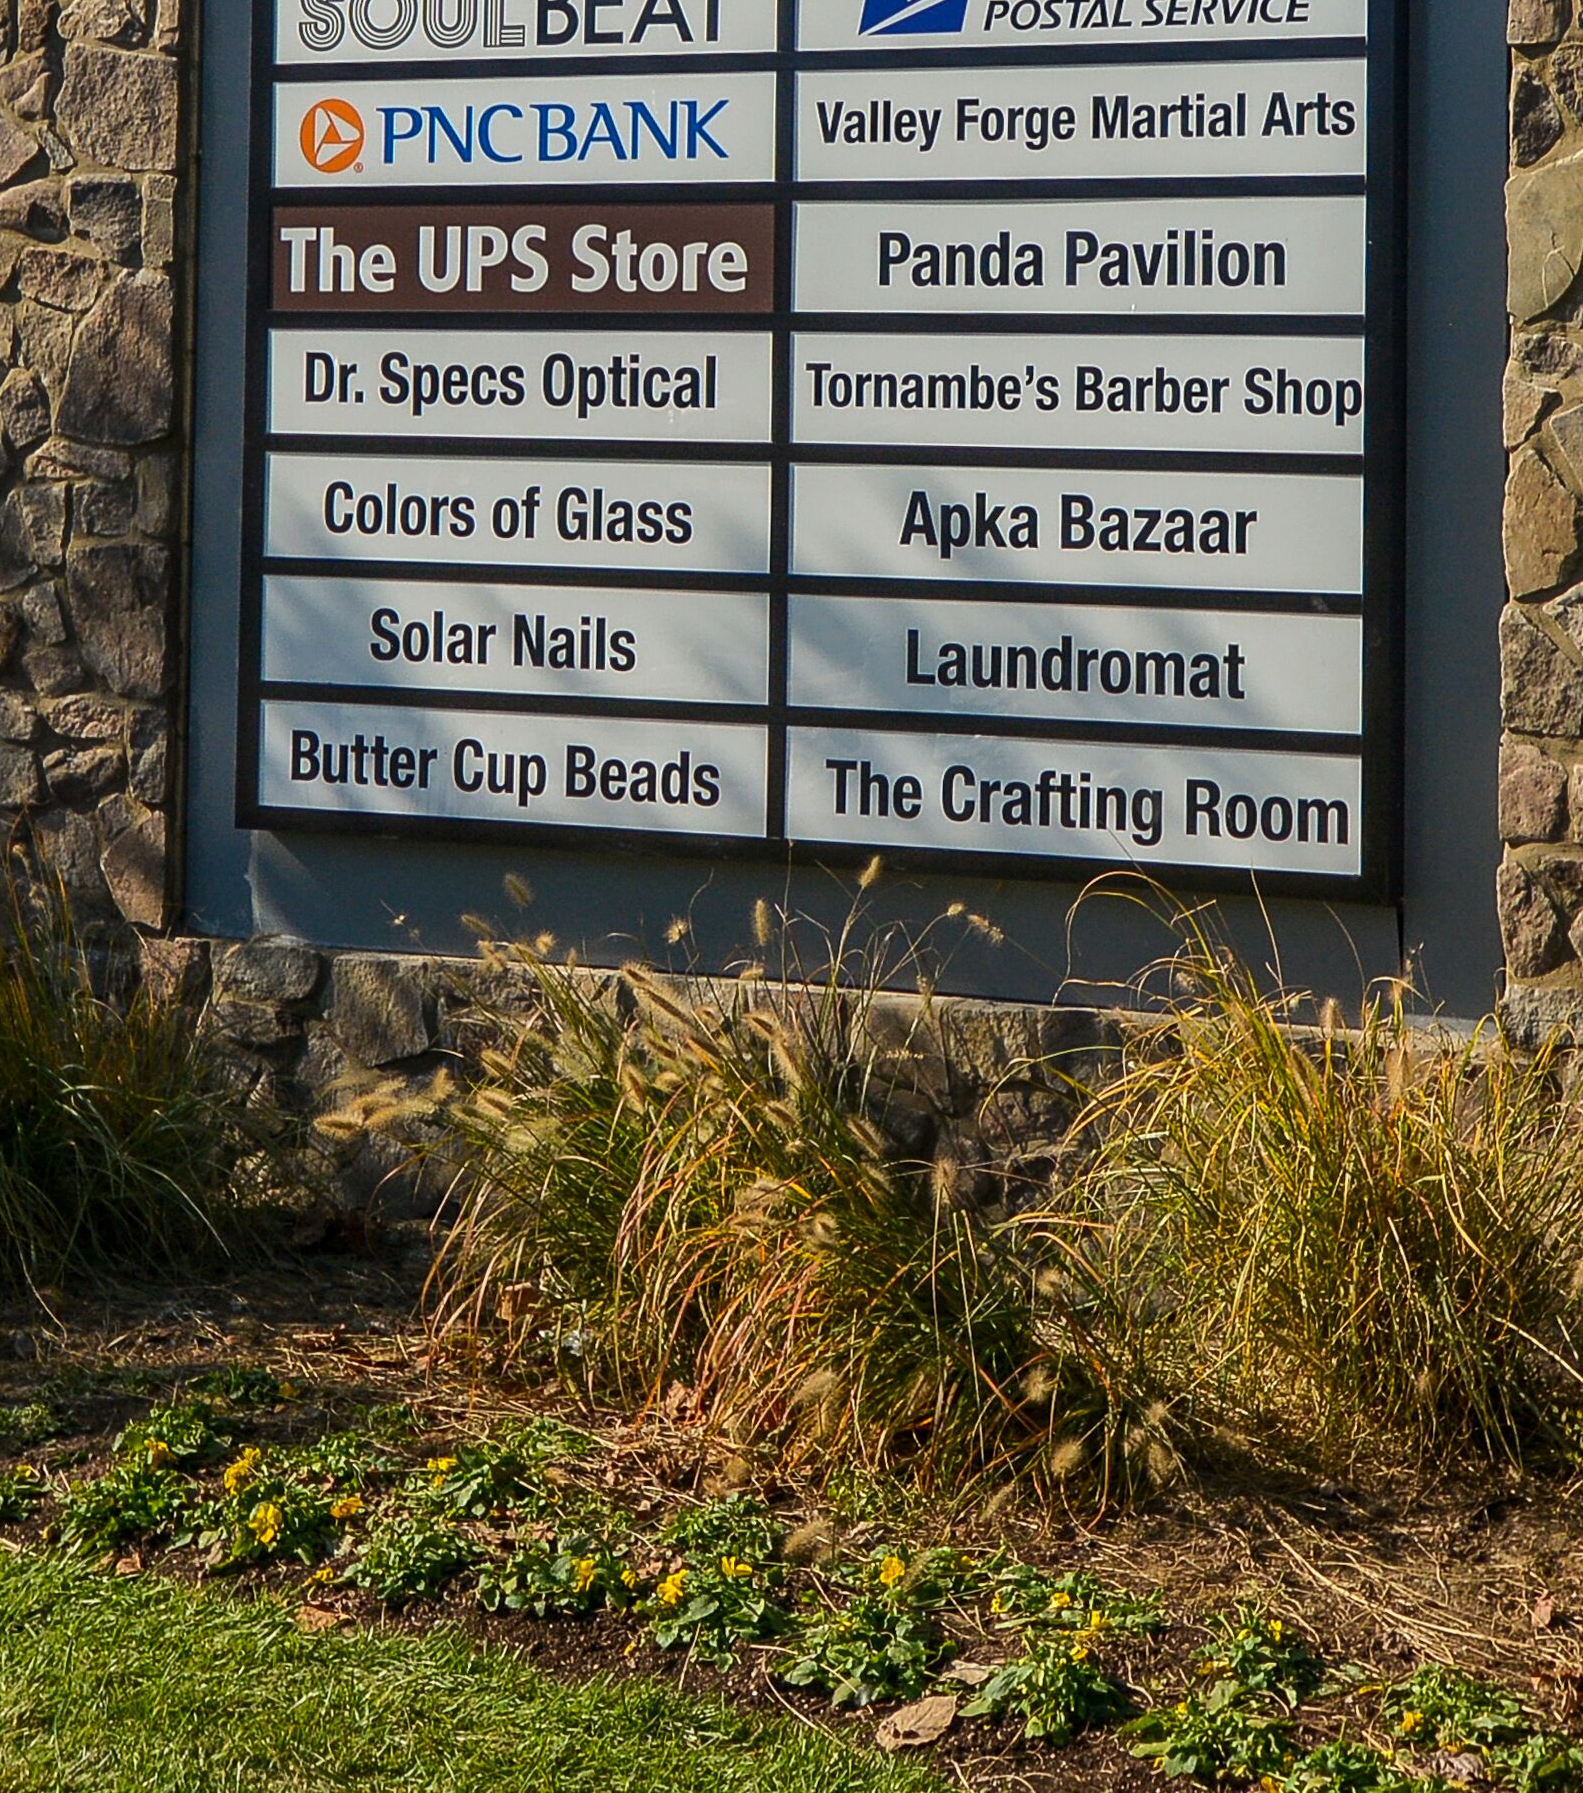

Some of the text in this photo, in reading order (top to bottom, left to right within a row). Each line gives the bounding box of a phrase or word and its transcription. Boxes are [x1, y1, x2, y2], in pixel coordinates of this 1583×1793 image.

[376, 100, 730, 164] PNC BANK
[817, 91, 1356, 153] Valley Forge Martial Arts
[281, 224, 747, 293] The UPS Store
[877, 230, 1288, 287] Panda Pavilion
[303, 351, 718, 420] Dr. Specs Optical
[806, 361, 1363, 426] Tornambe's Barber Shop
[322, 481, 693, 545] Colors of Glass
[900, 491, 1259, 561] Apka Bazaar
[369, 608, 637, 672] Solar Nails
[905, 628, 1246, 701] Laundromat
[290, 729, 721, 807] Butter Cup Beads
[826, 758, 1350, 845] The Crafting Room
